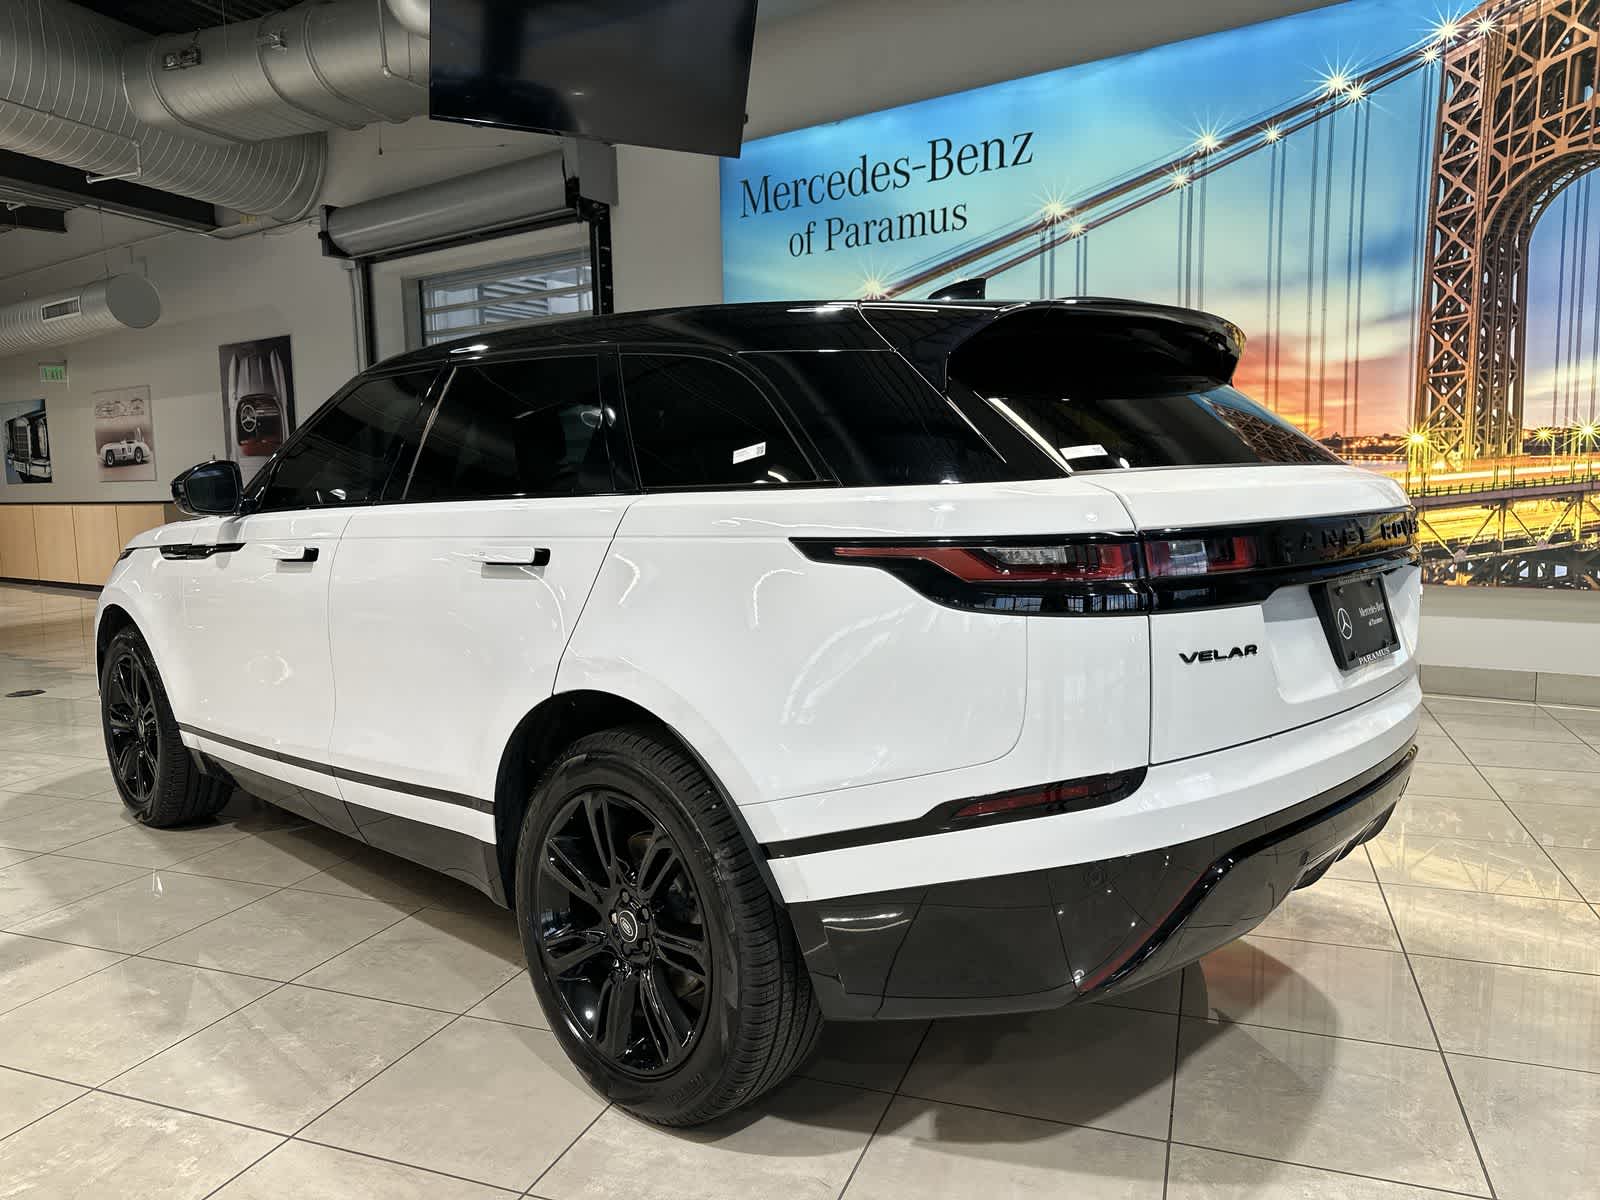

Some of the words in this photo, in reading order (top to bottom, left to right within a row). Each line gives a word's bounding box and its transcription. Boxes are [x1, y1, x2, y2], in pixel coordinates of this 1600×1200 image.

[740, 131, 1034, 218] Mercedes-Benz
[789, 221, 816, 257] of
[825, 203, 968, 252] Paramus
[1179, 644, 1258, 665] VELAR
[1358, 646, 1391, 665] PARAMUS
